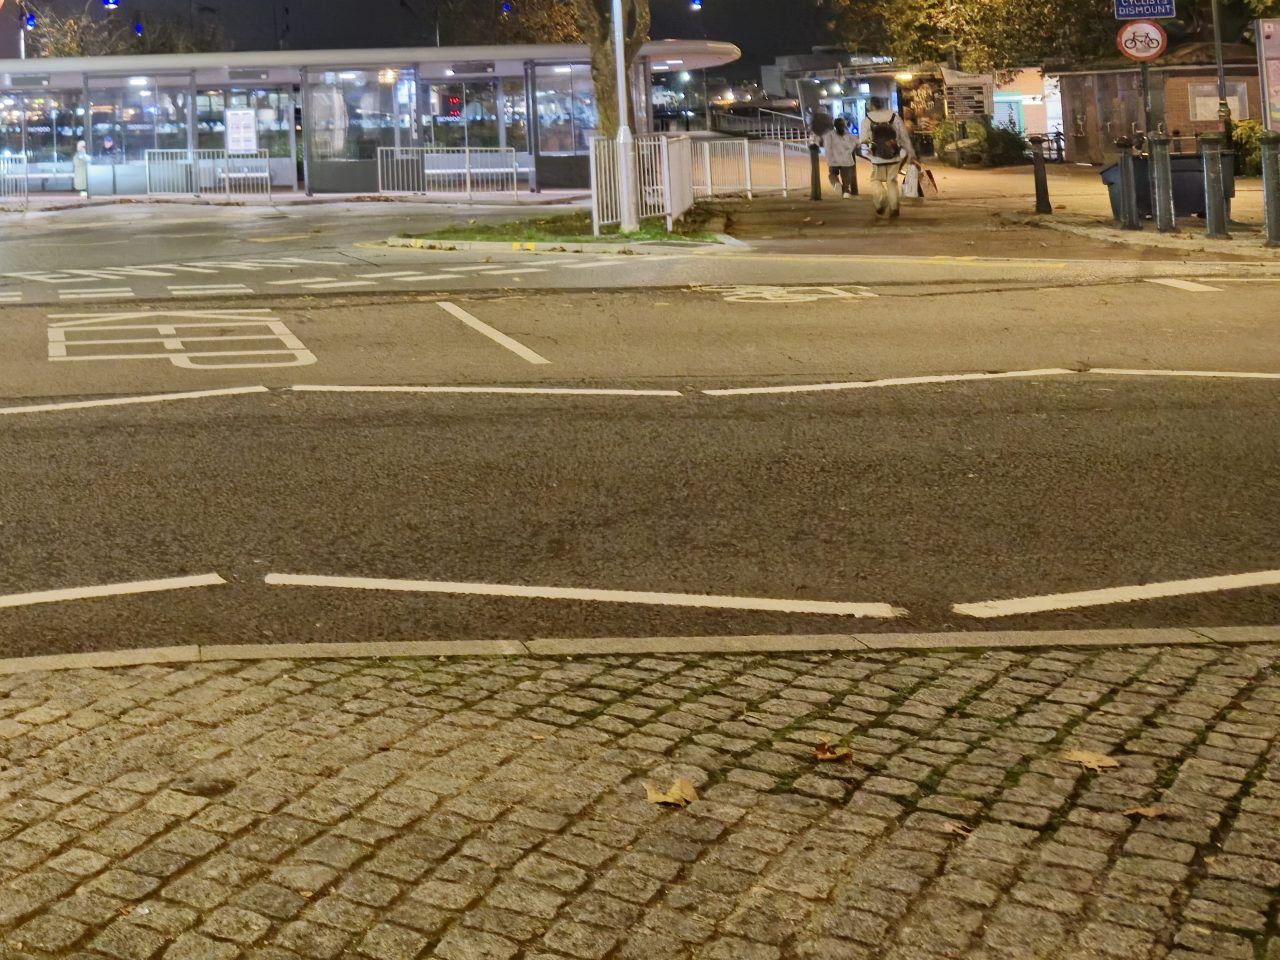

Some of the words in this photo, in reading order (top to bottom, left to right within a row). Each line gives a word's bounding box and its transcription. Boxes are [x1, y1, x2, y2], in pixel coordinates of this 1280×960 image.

[1119, 5, 1171, 15] DISMOUNT
[1, 257, 349, 283] ENTRY
[48, 308, 318, 369] KEEP
